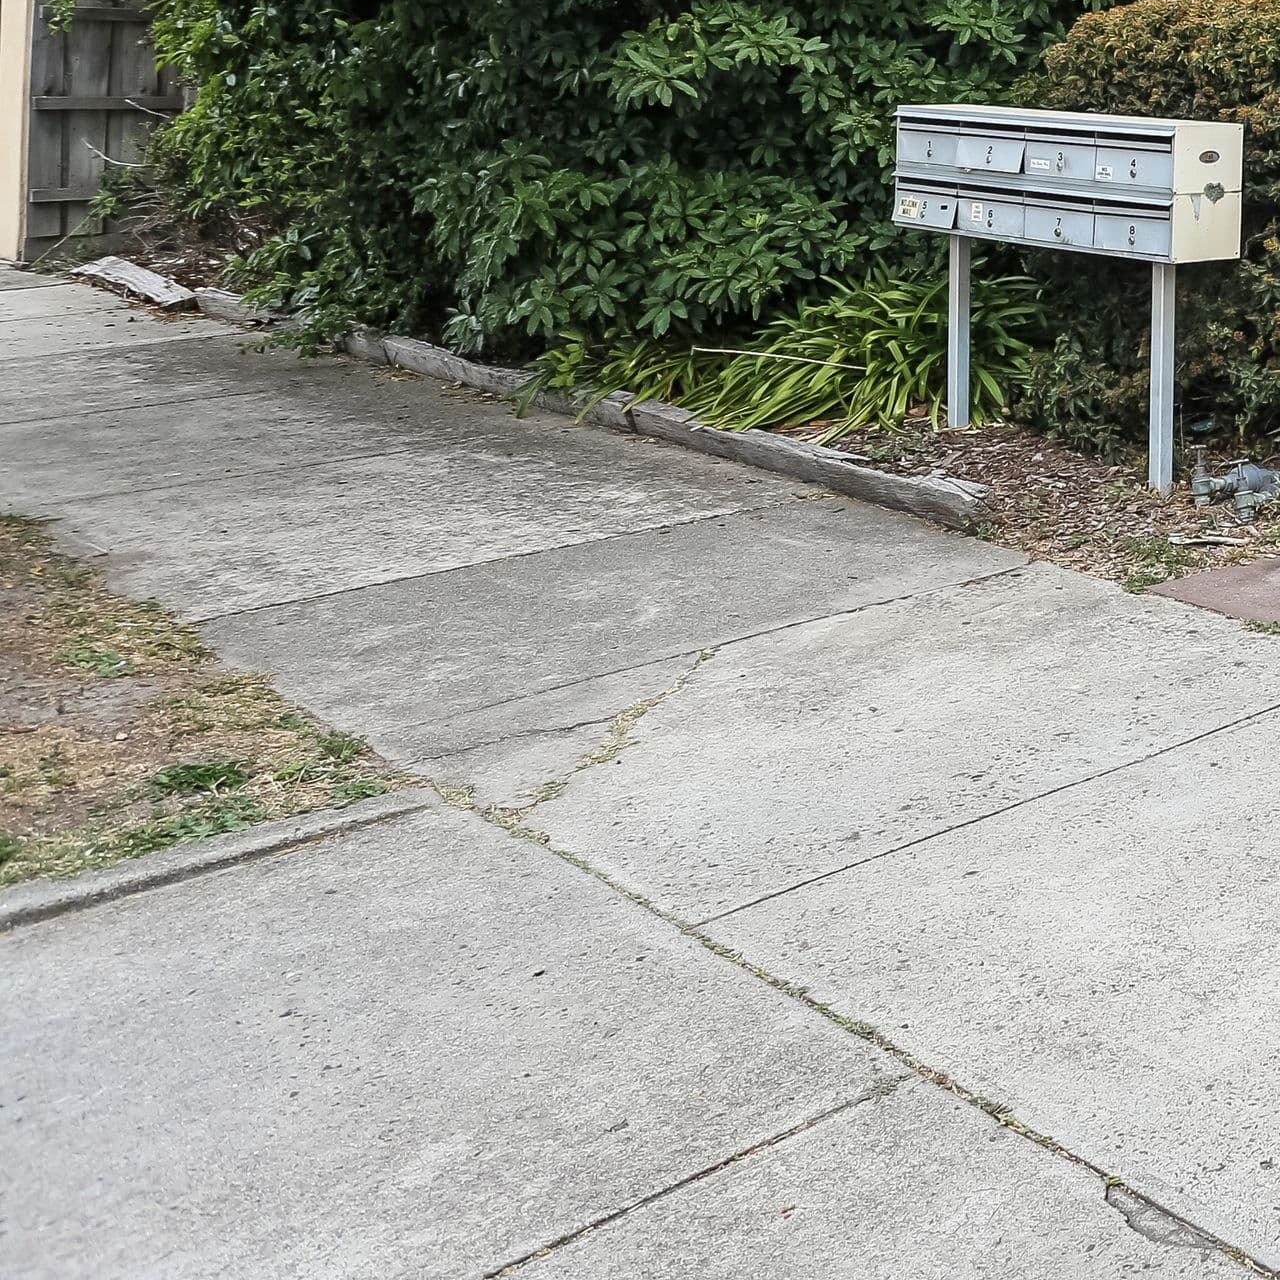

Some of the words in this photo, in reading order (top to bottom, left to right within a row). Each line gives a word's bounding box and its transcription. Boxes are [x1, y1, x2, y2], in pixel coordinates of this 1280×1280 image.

[987, 145, 994, 155] 2
[1056, 151, 1063, 162] 3
[1129, 158, 1136, 168] 4
[922, 201, 928, 210] 5
[988, 209, 994, 219] 6
[1055, 217, 1062, 227] 7
[1128, 225, 1135, 235] 8
